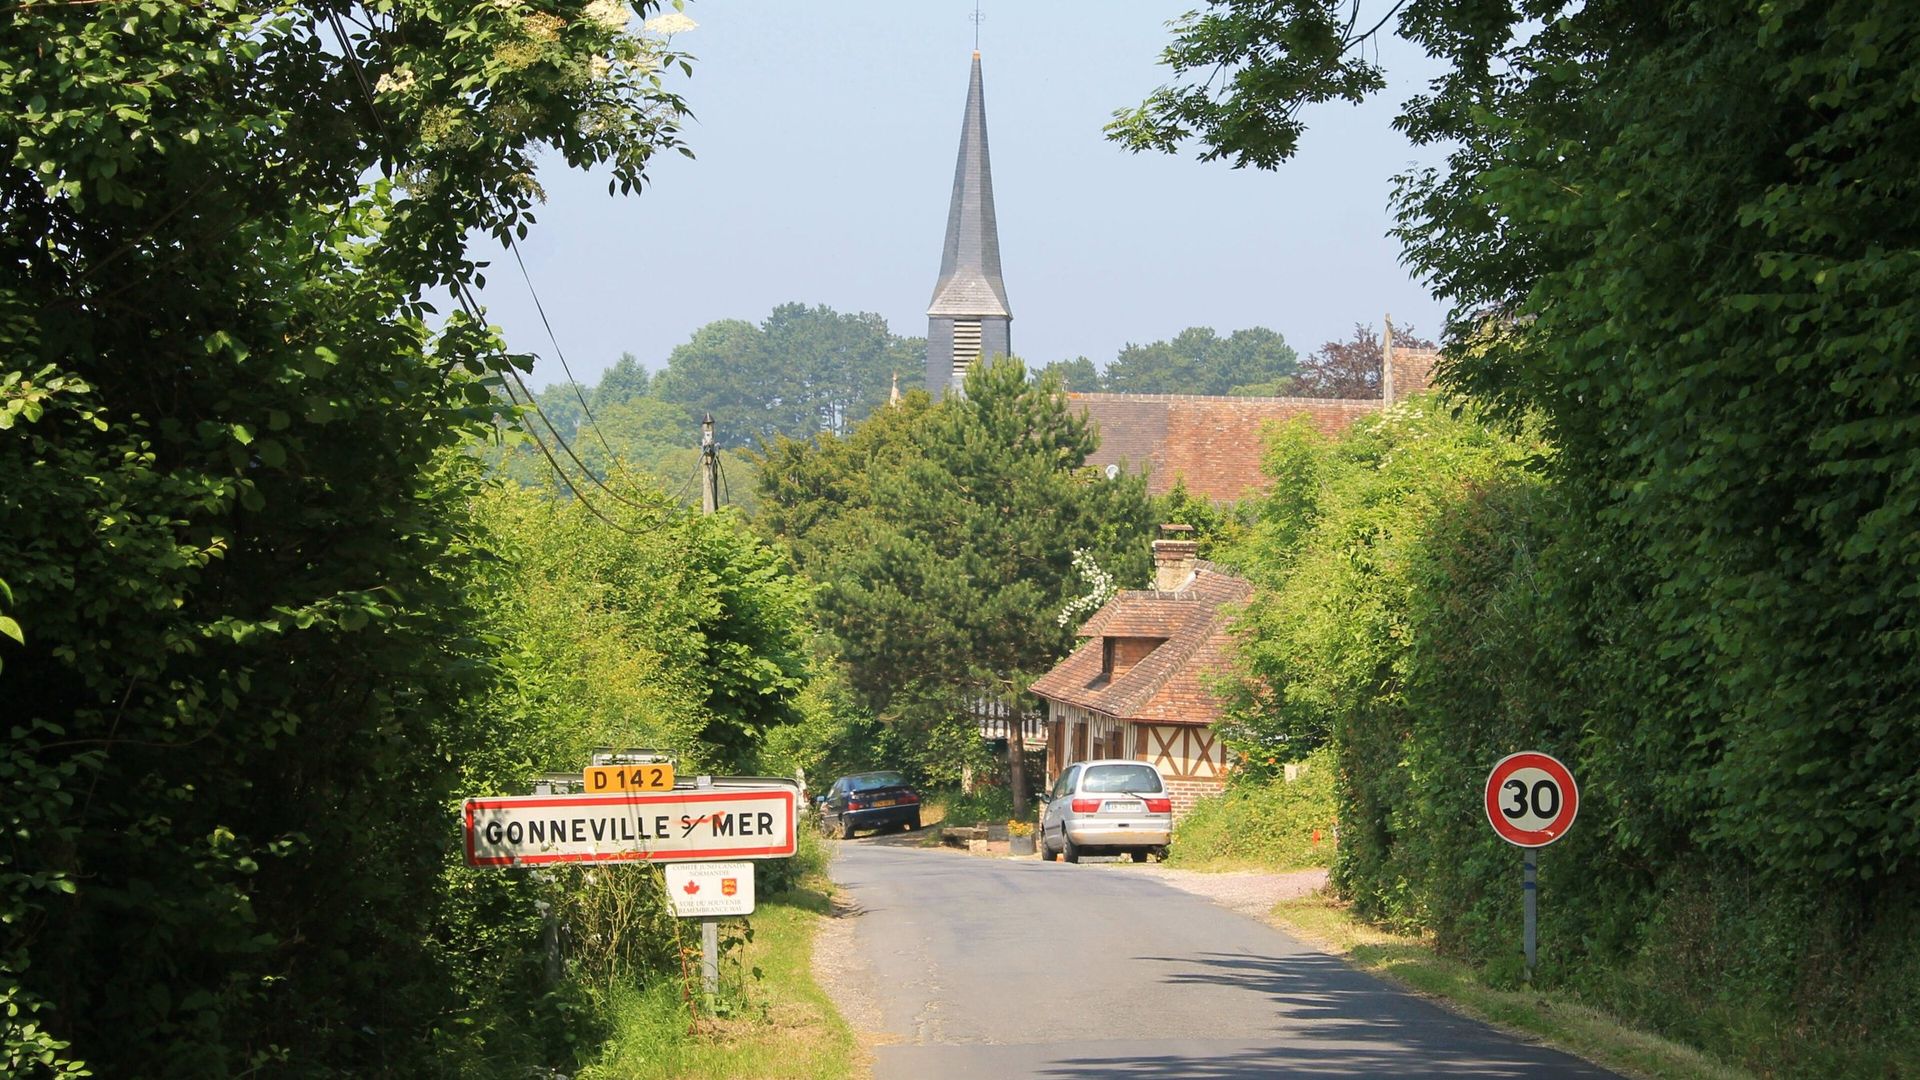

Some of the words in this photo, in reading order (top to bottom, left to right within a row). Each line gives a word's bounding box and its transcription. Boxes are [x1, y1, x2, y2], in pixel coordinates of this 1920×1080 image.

[594, 771, 607, 790] D
[616, 768, 664, 789] 142
[1502, 779, 1560, 819] 30
[485, 815, 670, 845] GONNEVILLE
[712, 812, 773, 837] MER
